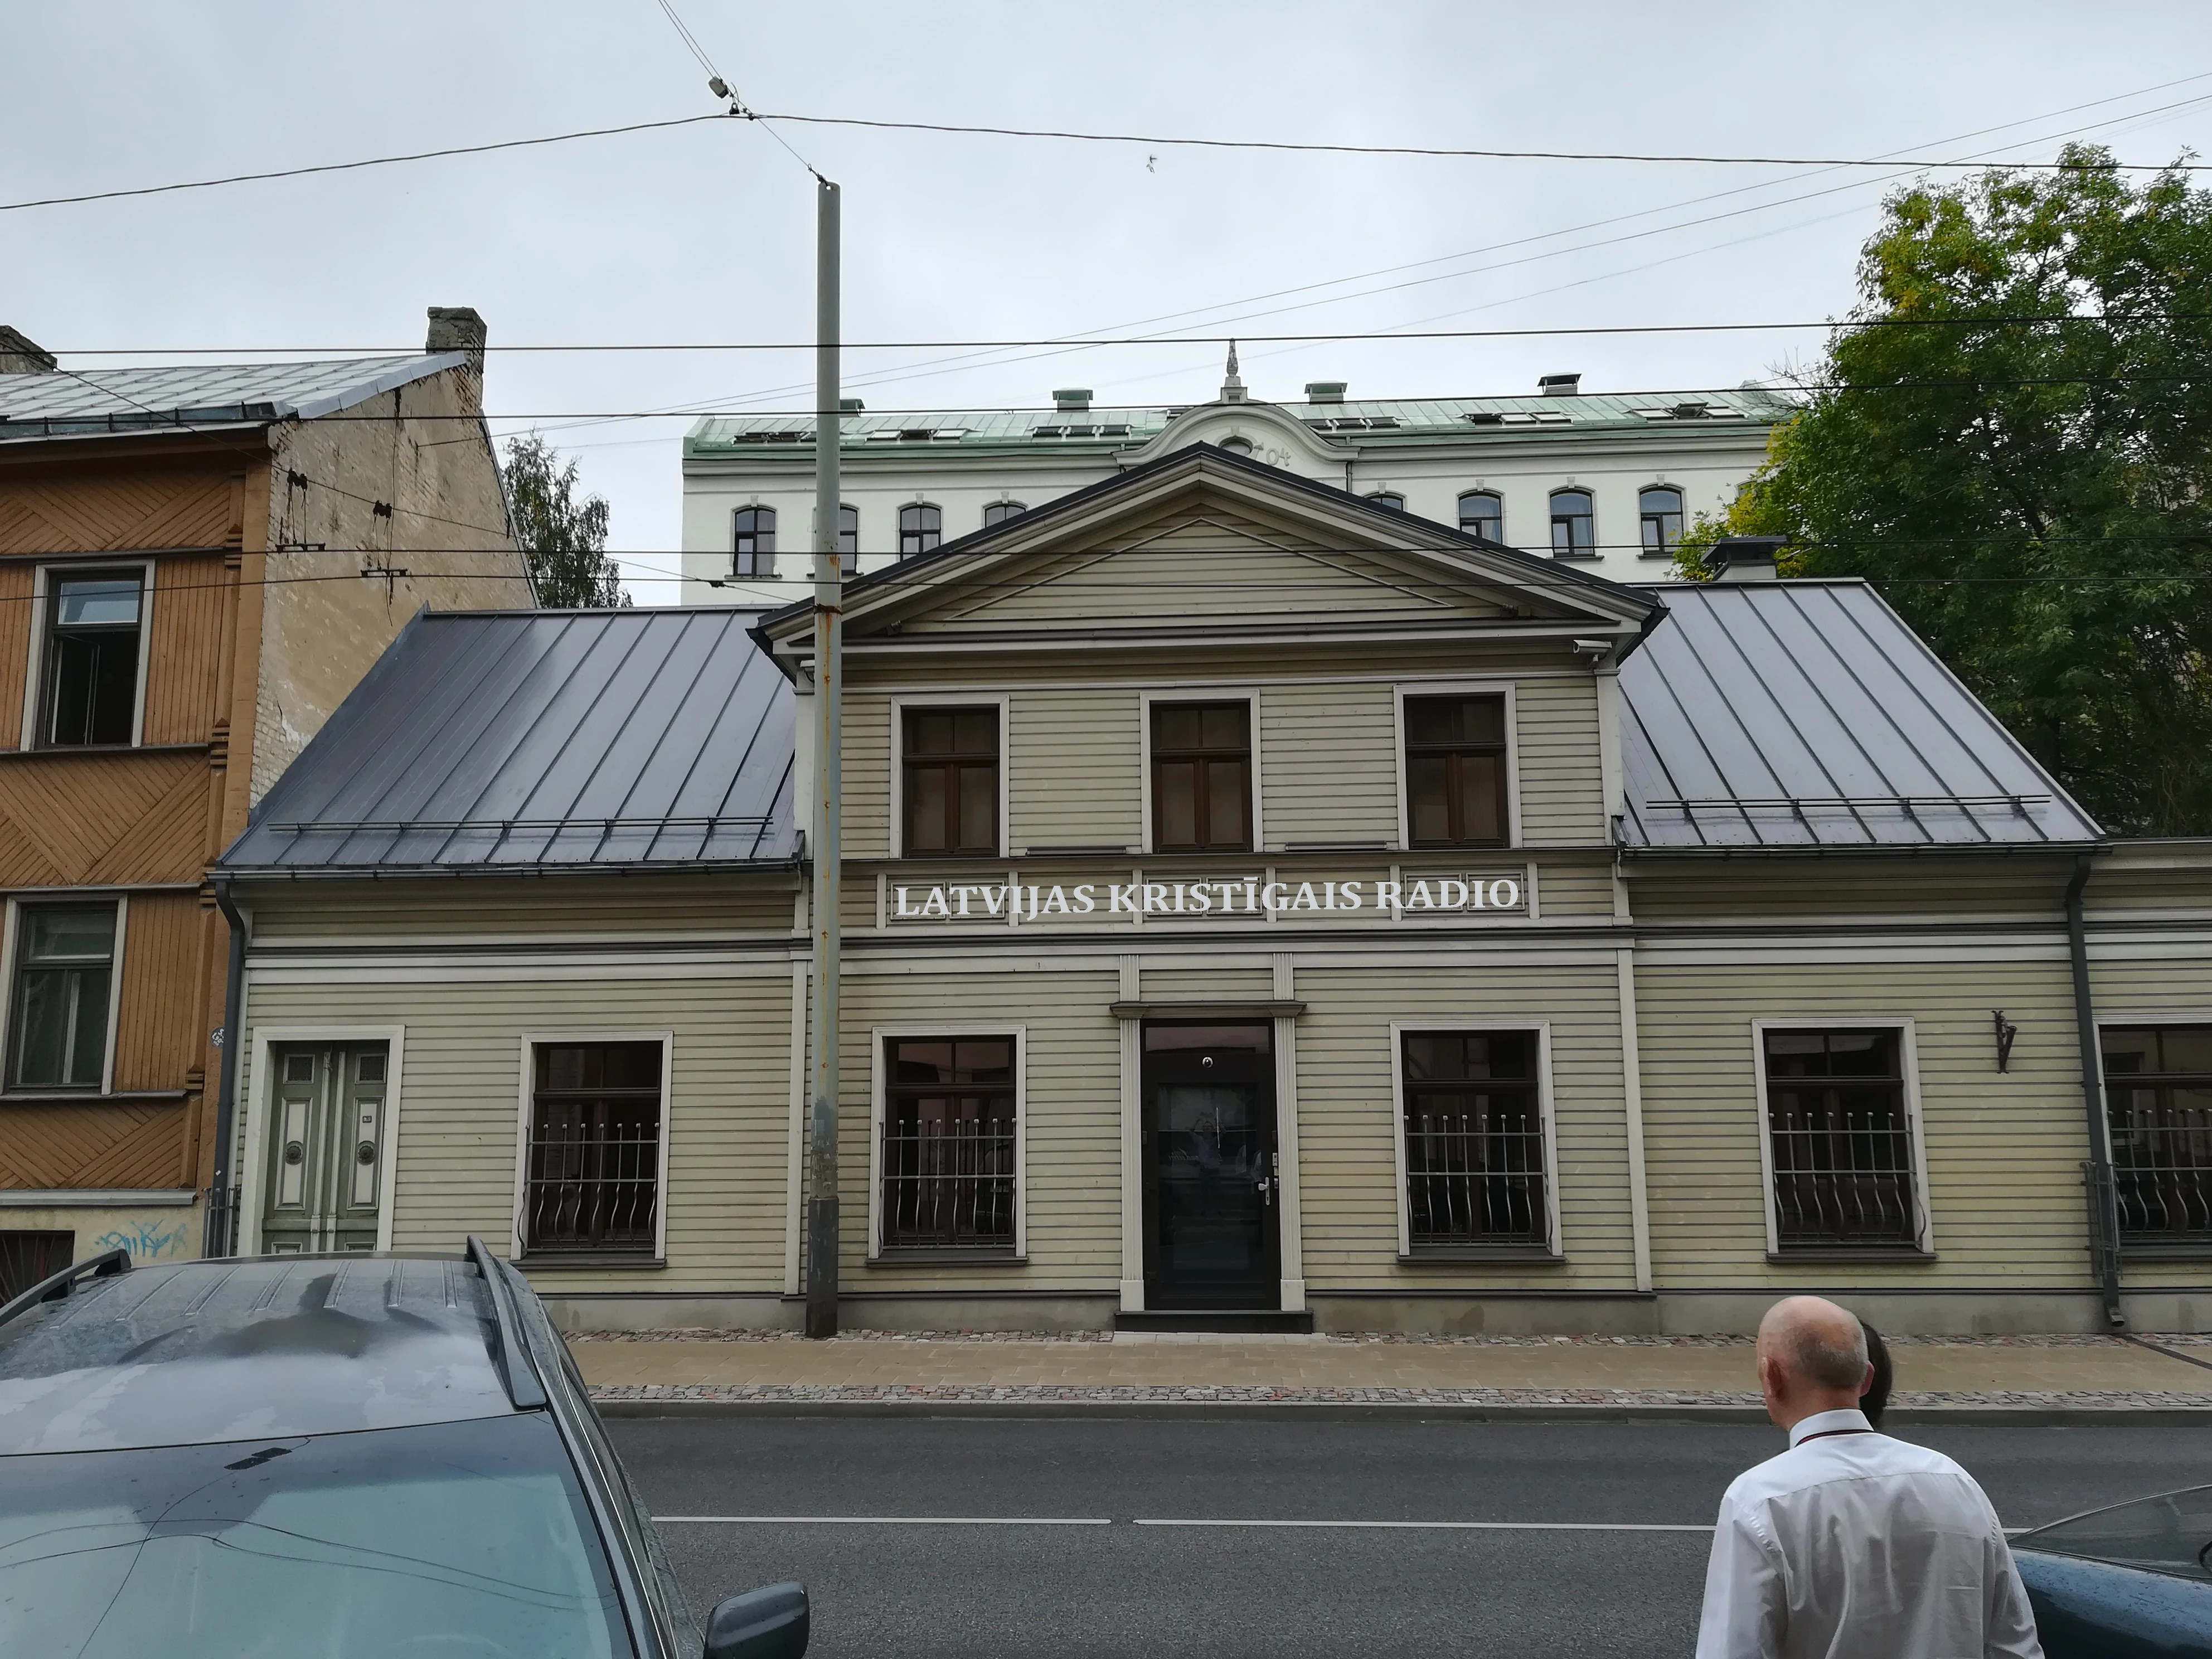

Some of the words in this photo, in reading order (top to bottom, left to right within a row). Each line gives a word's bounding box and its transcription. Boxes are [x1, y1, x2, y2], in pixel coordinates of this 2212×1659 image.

[895, 885, 1095, 921] LATVIJAS
[1108, 876, 1362, 913] KRISTĪGAIS
[1375, 879, 1519, 909] RADIO
